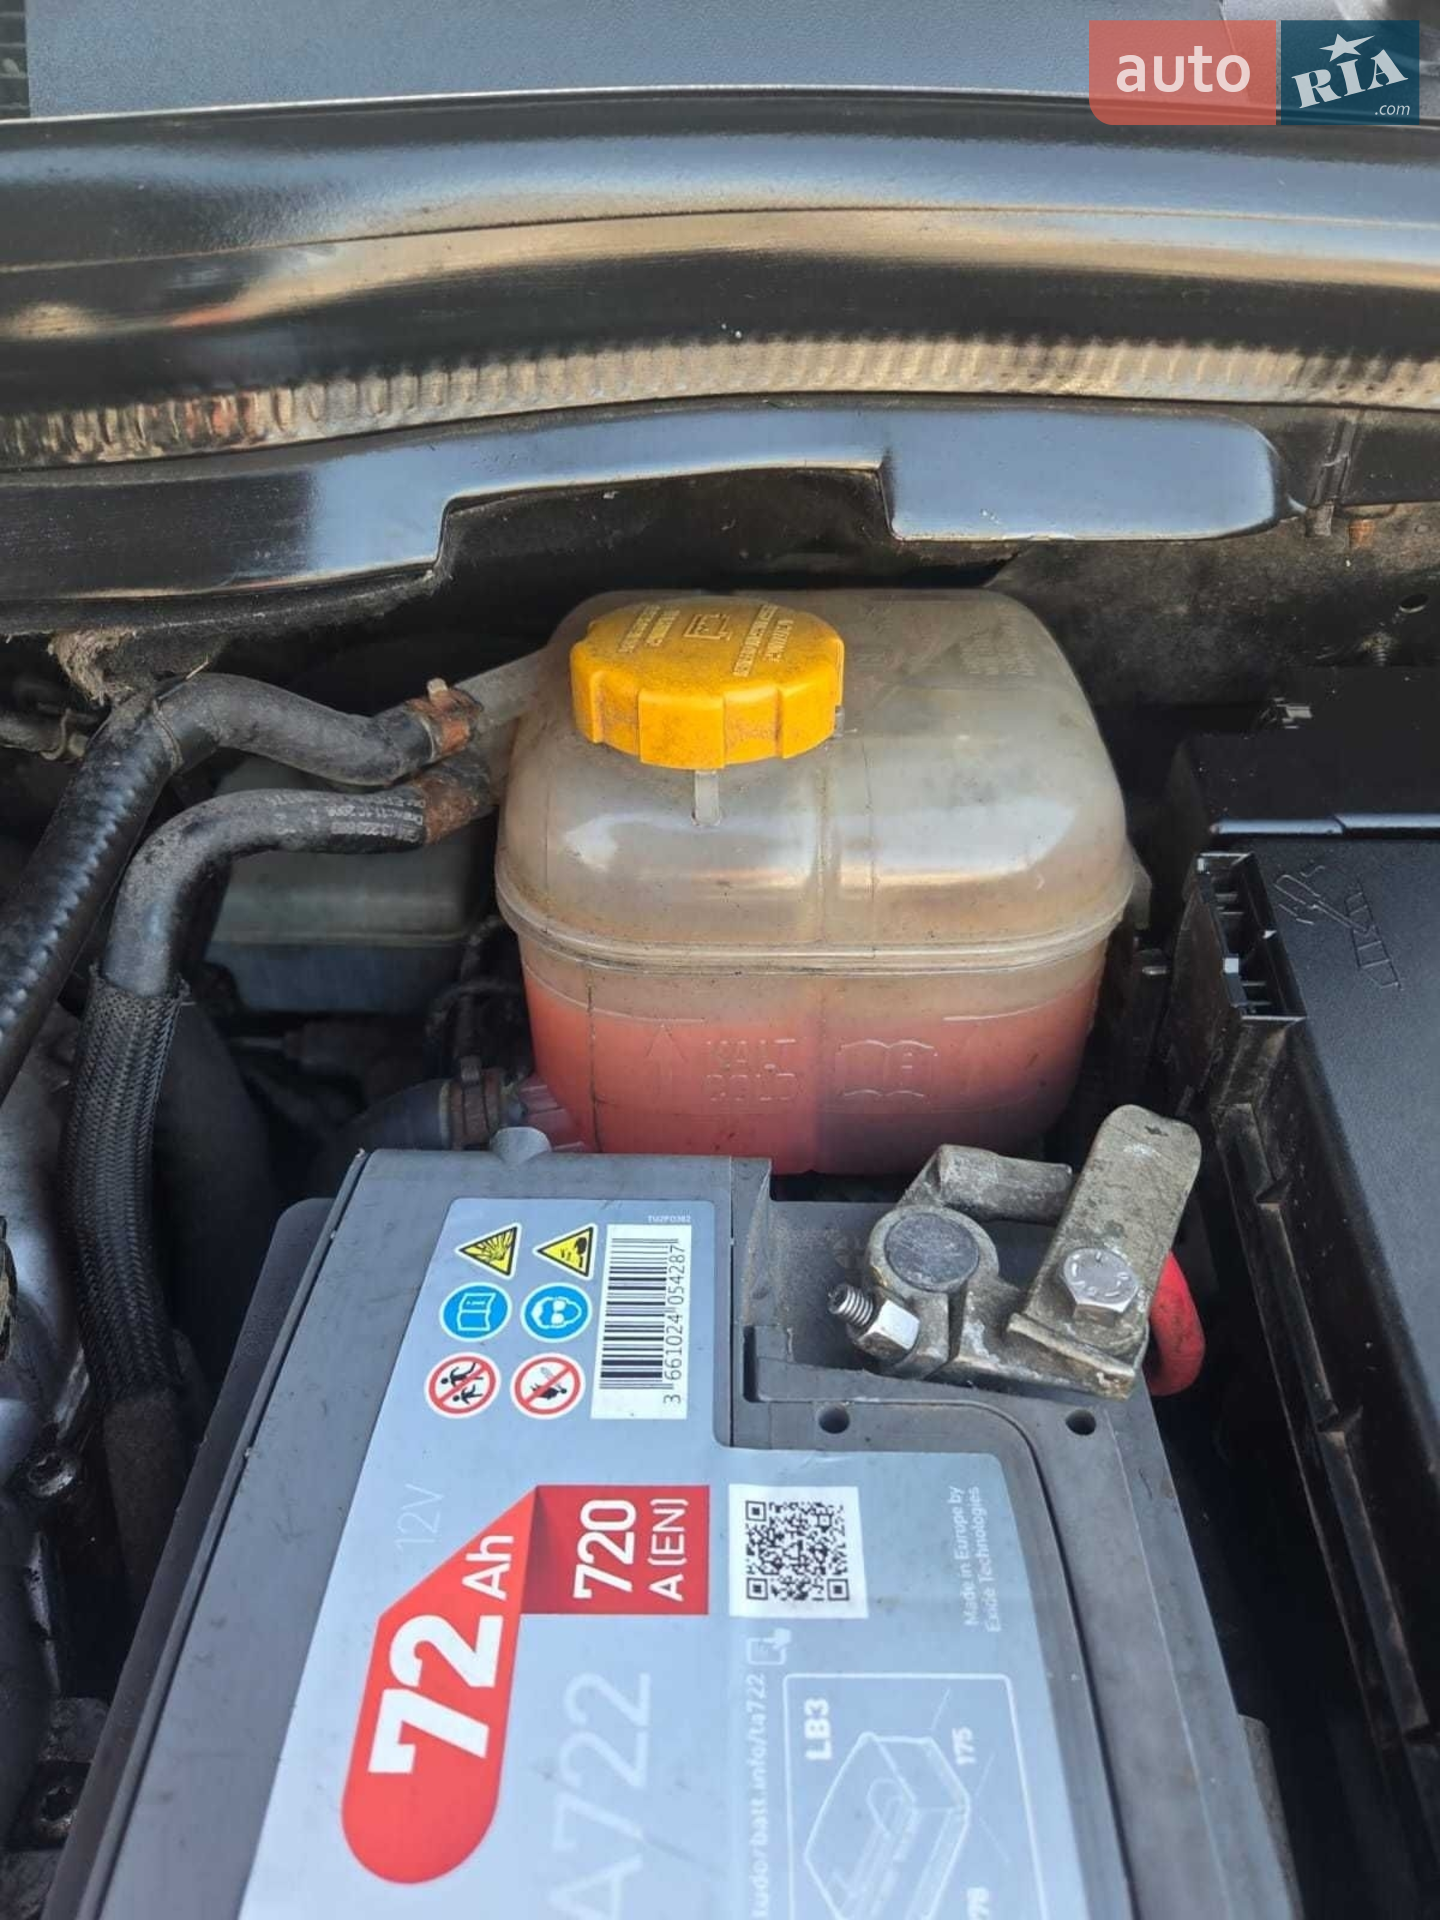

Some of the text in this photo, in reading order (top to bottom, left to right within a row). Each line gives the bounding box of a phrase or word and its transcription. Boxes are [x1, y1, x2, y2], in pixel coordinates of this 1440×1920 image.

[667, 1245, 686, 1310] 054287
[665, 1314, 684, 1381] 661024
[394, 1483, 444, 1549] 12V
[573, 1499, 637, 1599] 720
[647, 1498, 689, 1602] A (EN)
[947, 1486, 980, 1625] Made in Europe by
[967, 1486, 992, 1584] Technologies
[367, 1535, 515, 1774] 72 Ah
[804, 1698, 832, 1761] LB3
[952, 1727, 976, 1765] 175
